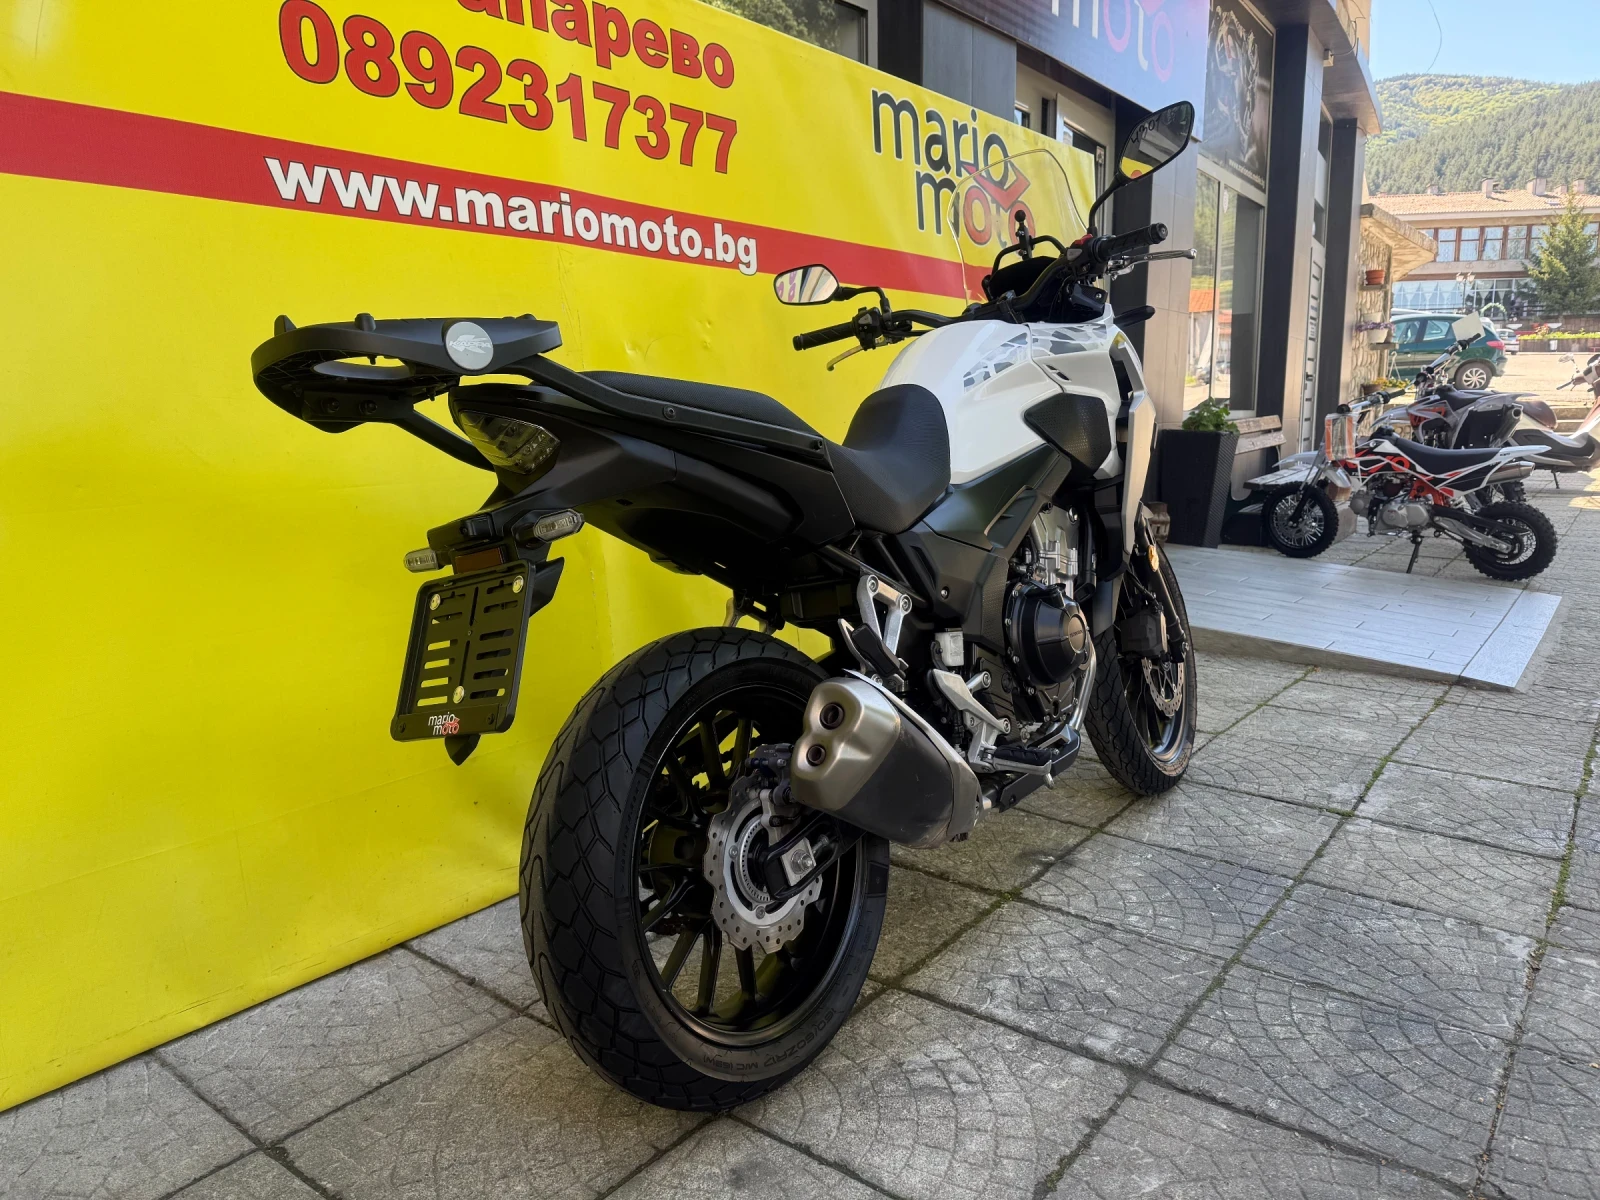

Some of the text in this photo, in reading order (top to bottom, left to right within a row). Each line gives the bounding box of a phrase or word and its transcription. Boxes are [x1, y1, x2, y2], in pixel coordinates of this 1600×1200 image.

[279, 0, 738, 174] 0892317377
[871, 89, 1010, 188] mario
[263, 156, 758, 276] www.mariomoto.bg
[915, 170, 1036, 249] moto
[428, 711, 456, 726] mario
[432, 722, 460, 736] moto
